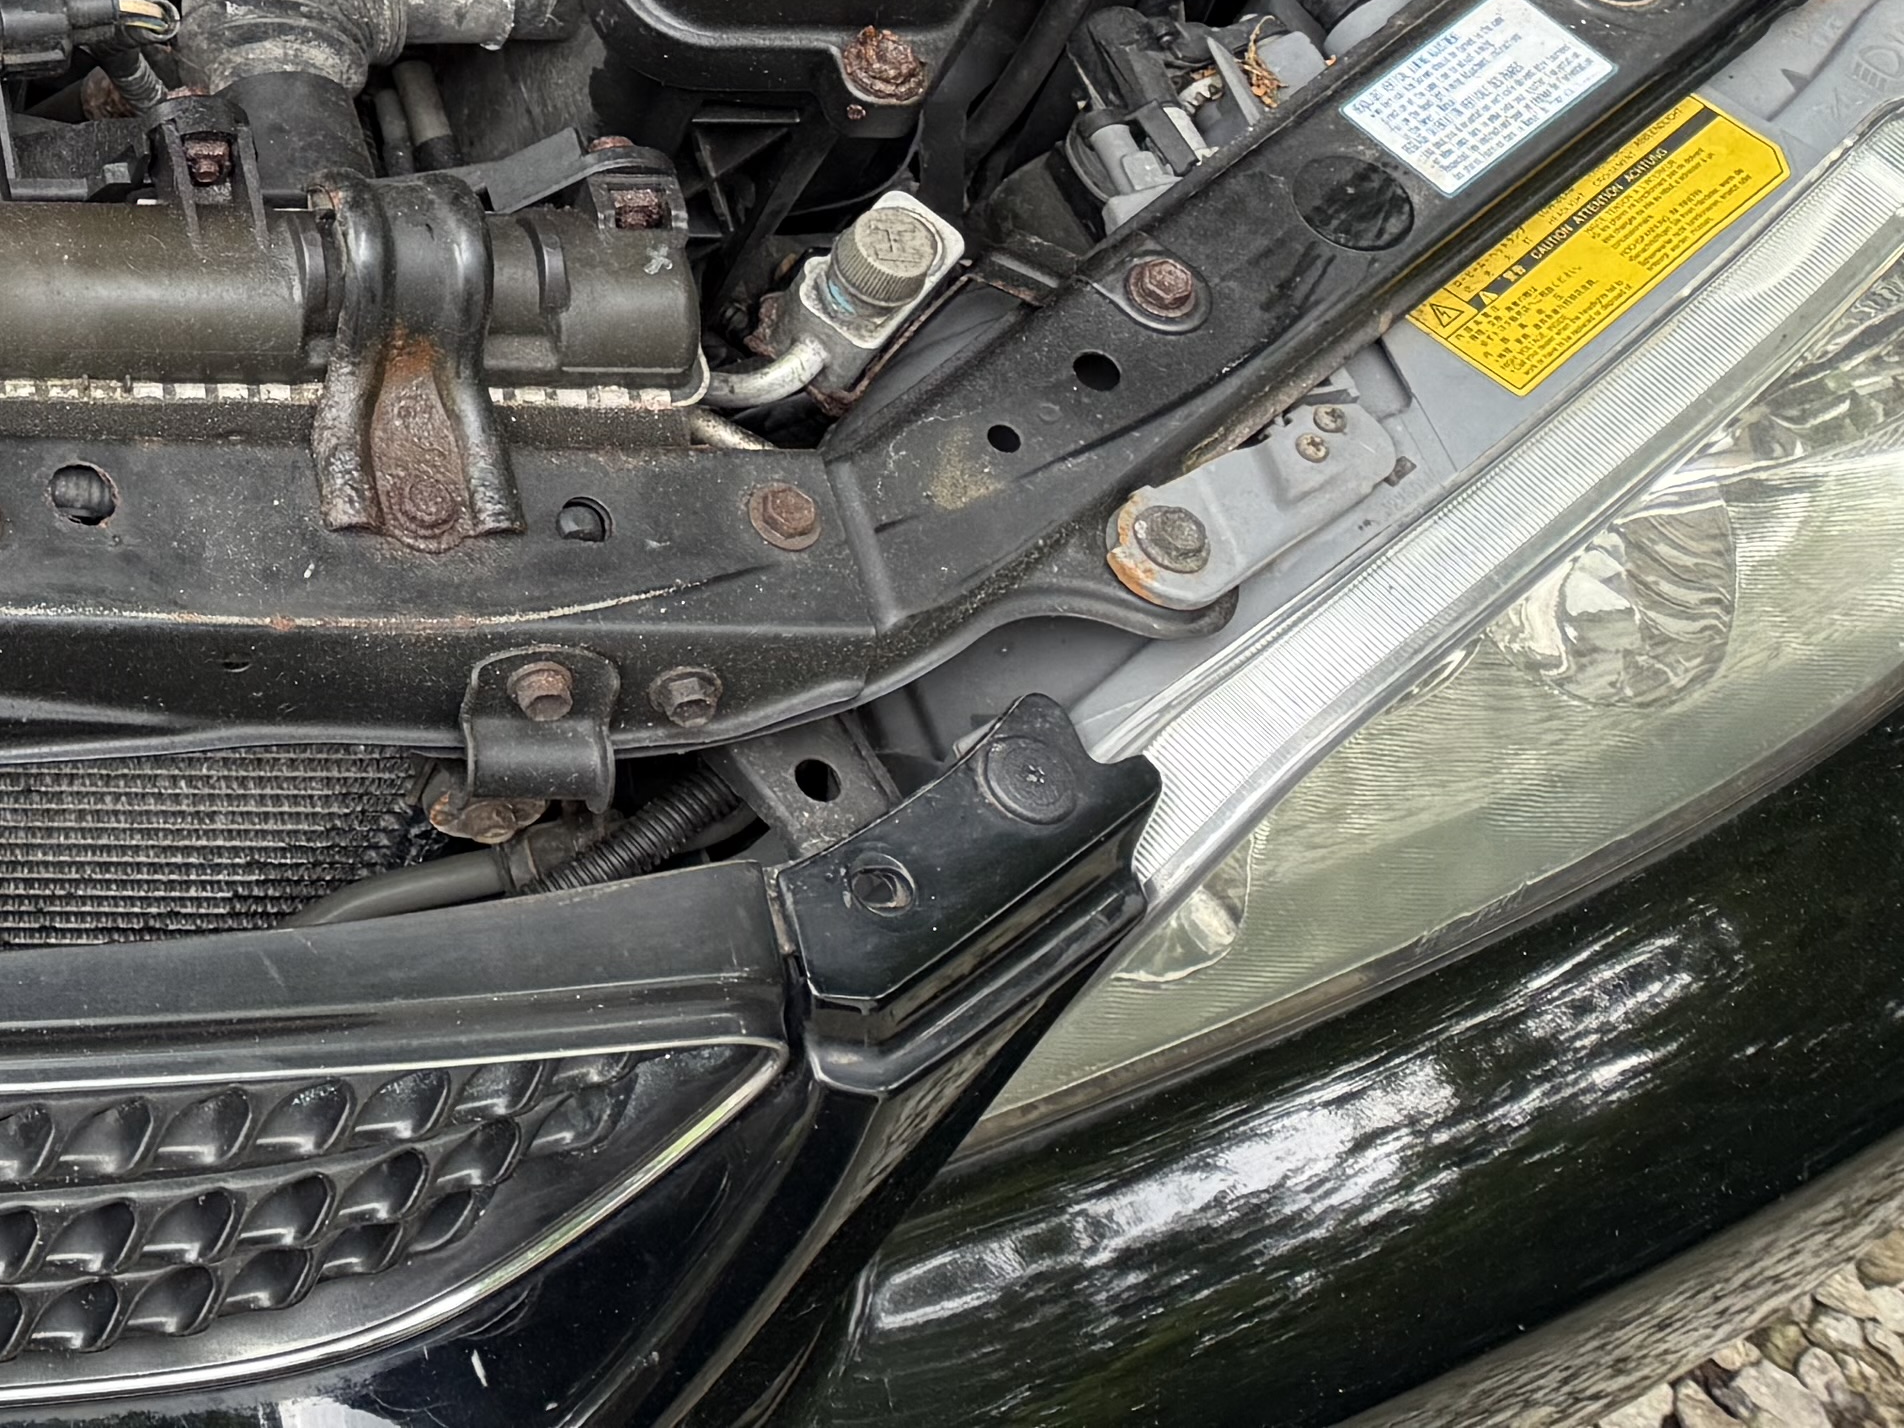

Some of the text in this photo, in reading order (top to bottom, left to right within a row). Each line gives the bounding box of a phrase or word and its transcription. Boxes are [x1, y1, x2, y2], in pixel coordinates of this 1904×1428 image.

[1526, 144, 1671, 261] CAUTION ATTENTION ACHTUNG
